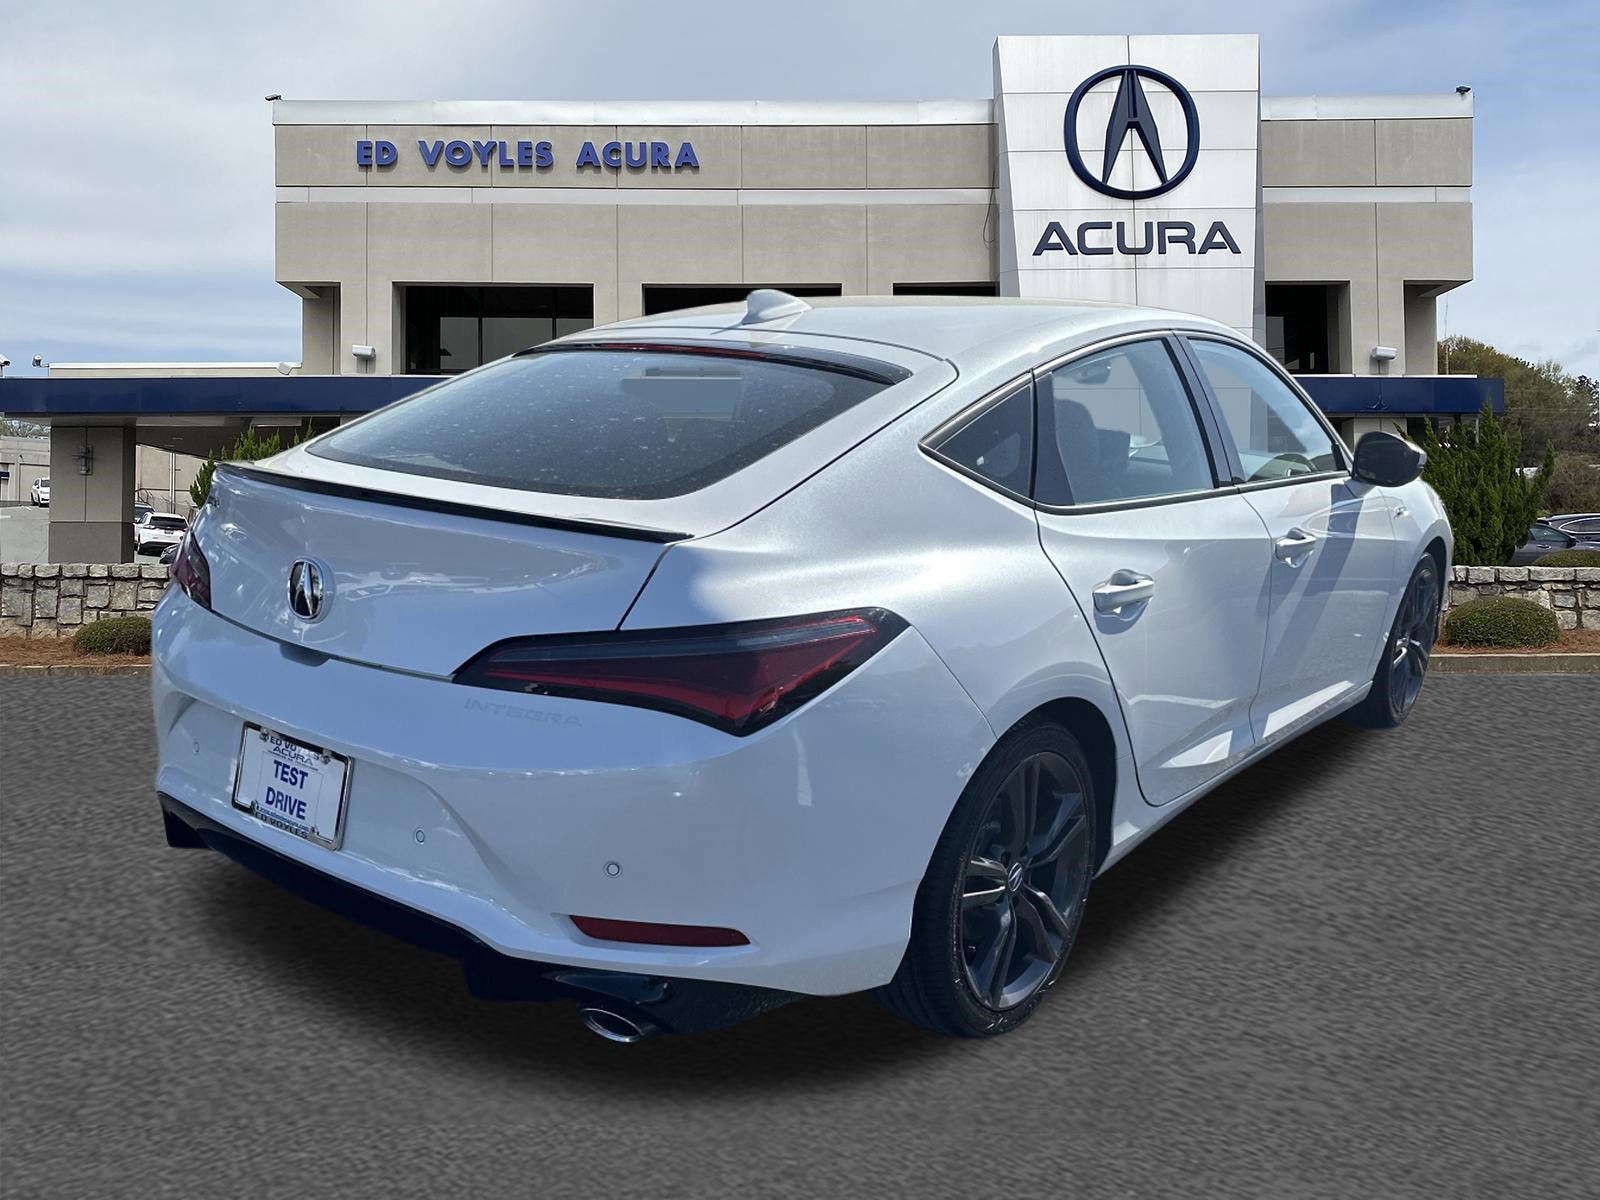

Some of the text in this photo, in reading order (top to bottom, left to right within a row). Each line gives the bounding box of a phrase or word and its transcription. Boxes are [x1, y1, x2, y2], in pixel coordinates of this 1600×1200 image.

[356, 140, 700, 169] ED VOYLES ACURA
[1032, 221, 1242, 256] ACURA
[464, 698, 583, 728] INTEGRA
[269, 735, 283, 746] ED
[272, 746, 313, 766] ACURA
[273, 759, 309, 789] TEST
[265, 786, 307, 820] DRIVE
